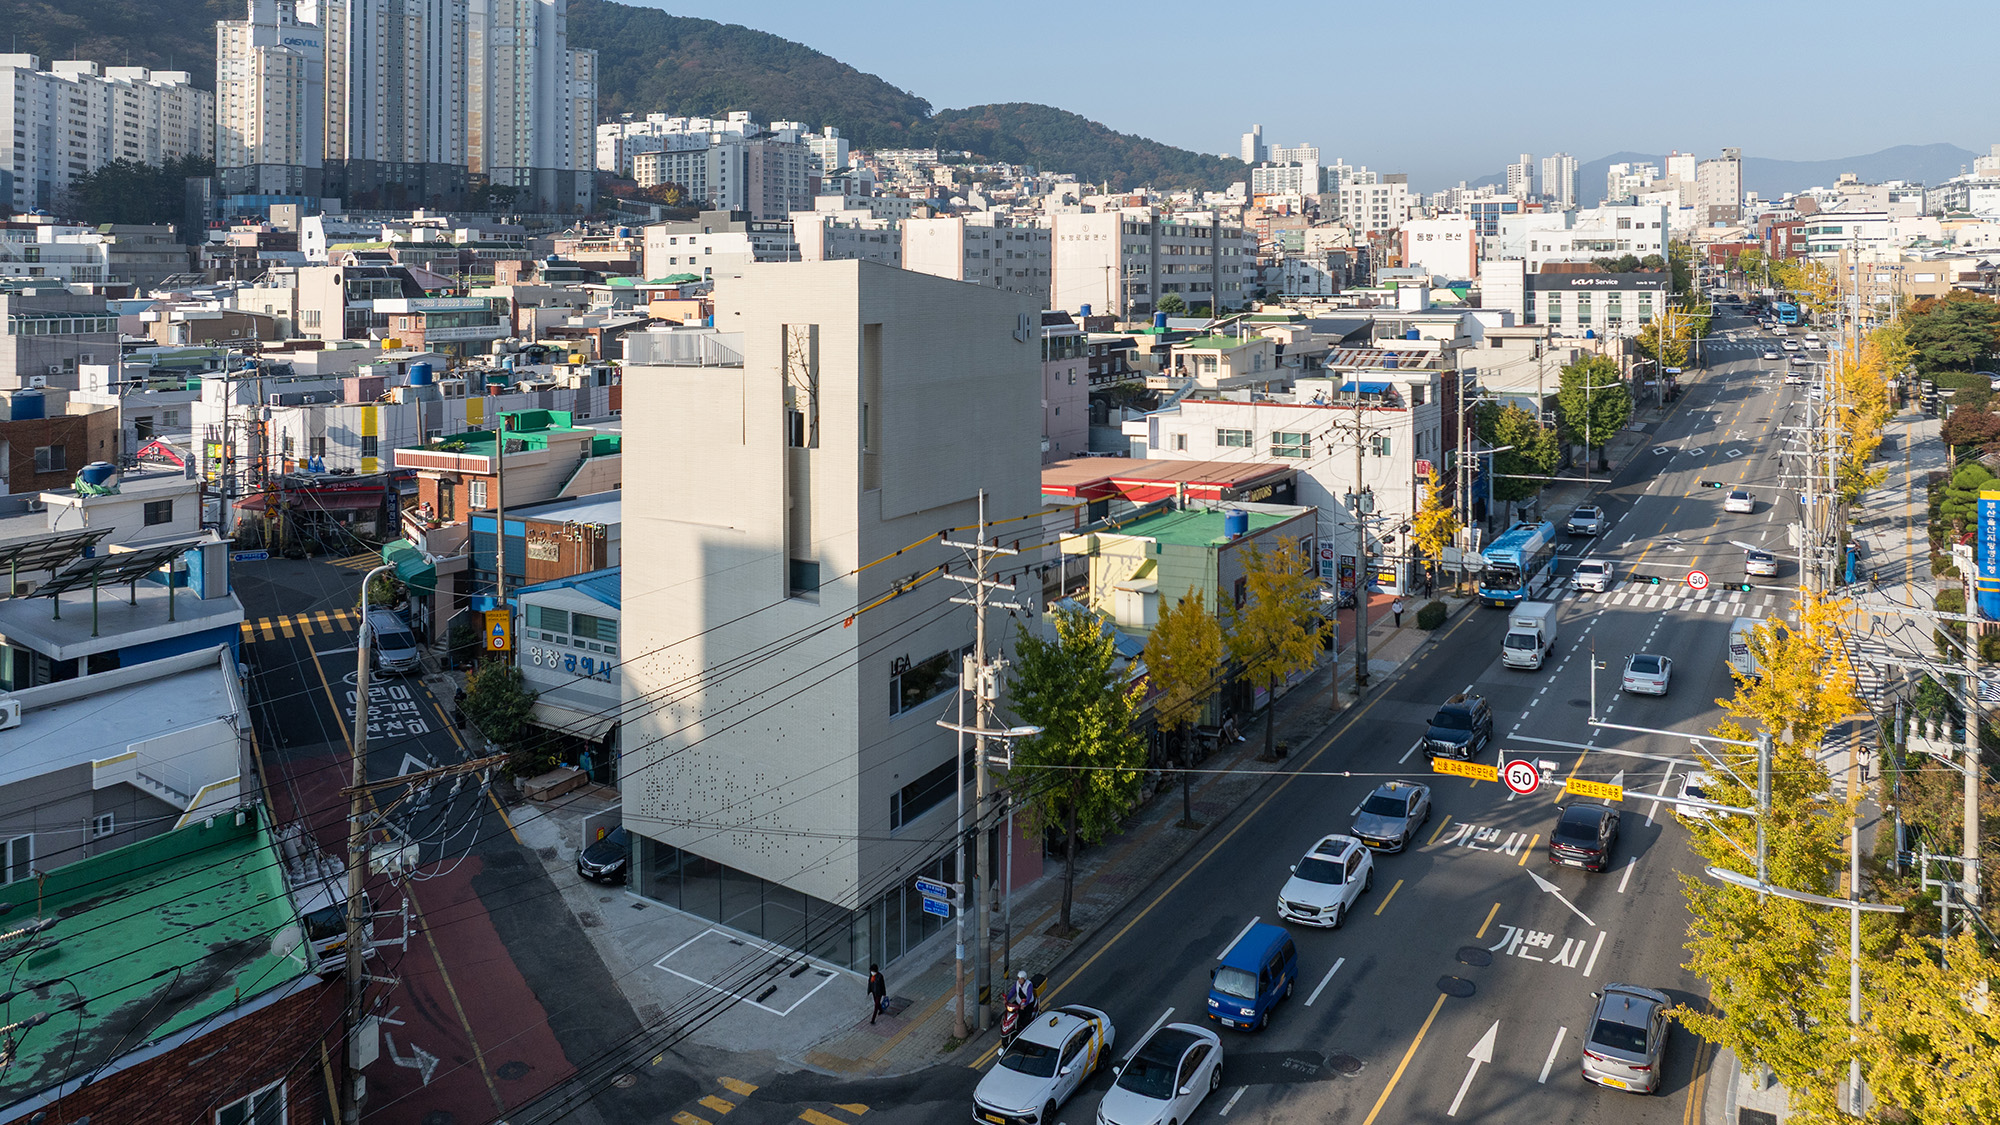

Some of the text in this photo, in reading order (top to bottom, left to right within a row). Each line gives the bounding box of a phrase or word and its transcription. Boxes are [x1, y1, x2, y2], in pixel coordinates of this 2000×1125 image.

[90, 373, 98, 392] B
[1692, 575, 1703, 584] 50
[531, 646, 560, 669] 영창
[564, 653, 612, 679] 공예사
[1512, 770, 1532, 786] 50
